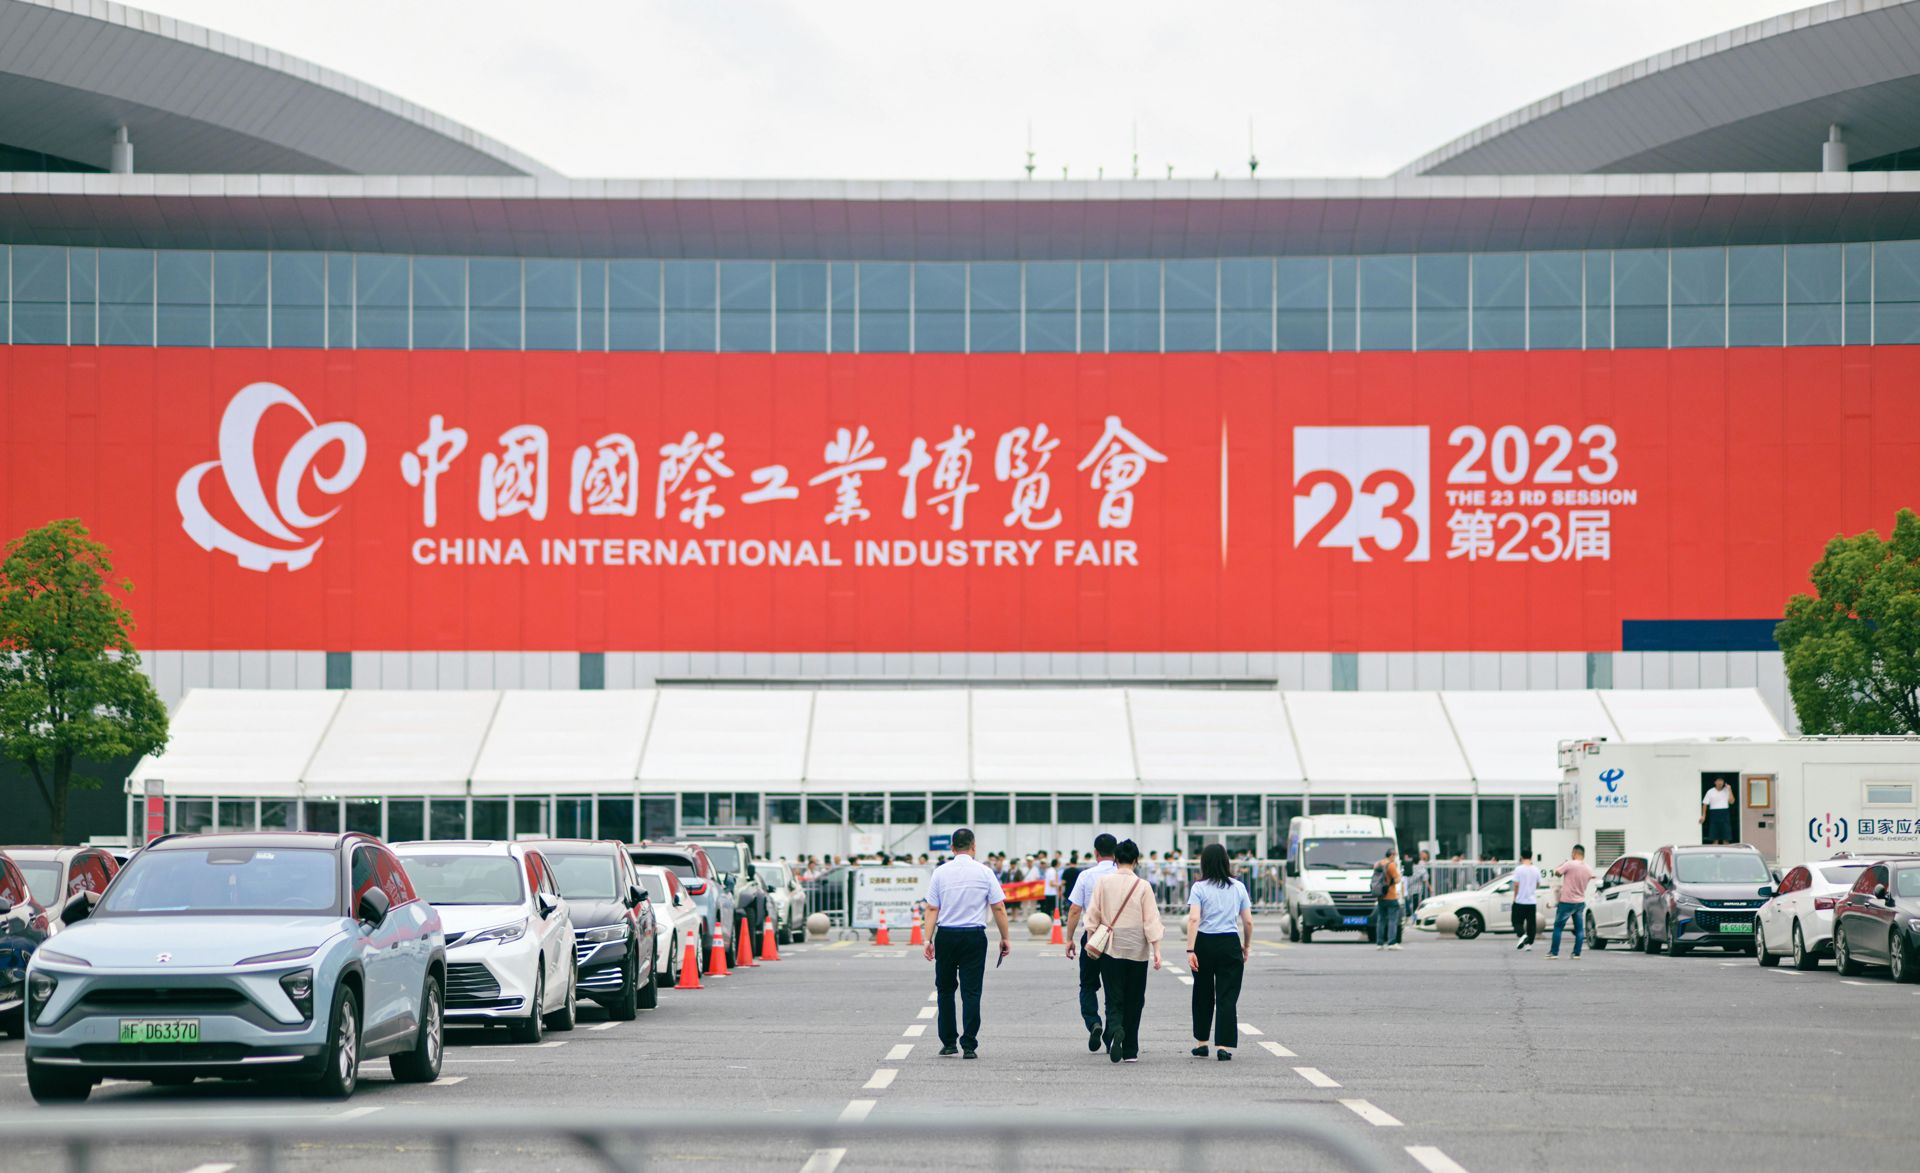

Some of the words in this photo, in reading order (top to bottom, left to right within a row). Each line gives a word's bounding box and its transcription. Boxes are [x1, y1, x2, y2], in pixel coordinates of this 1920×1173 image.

[401, 415, 1168, 530] 中國國際工業博覽會
[1447, 424, 1618, 484] 2023
[1294, 469, 1418, 562] 23
[1446, 490, 1485, 505] THE
[1491, 490, 1514, 505] 23
[1520, 490, 1546, 505] RD
[1552, 489, 1637, 505] SESSION
[412, 538, 529, 565] CHINA
[542, 539, 842, 566] INTERNATIONAL
[855, 540, 1042, 566] INDUSTRY
[1055, 540, 1138, 566] FAIR
[1446, 509, 1610, 562] 第23届
